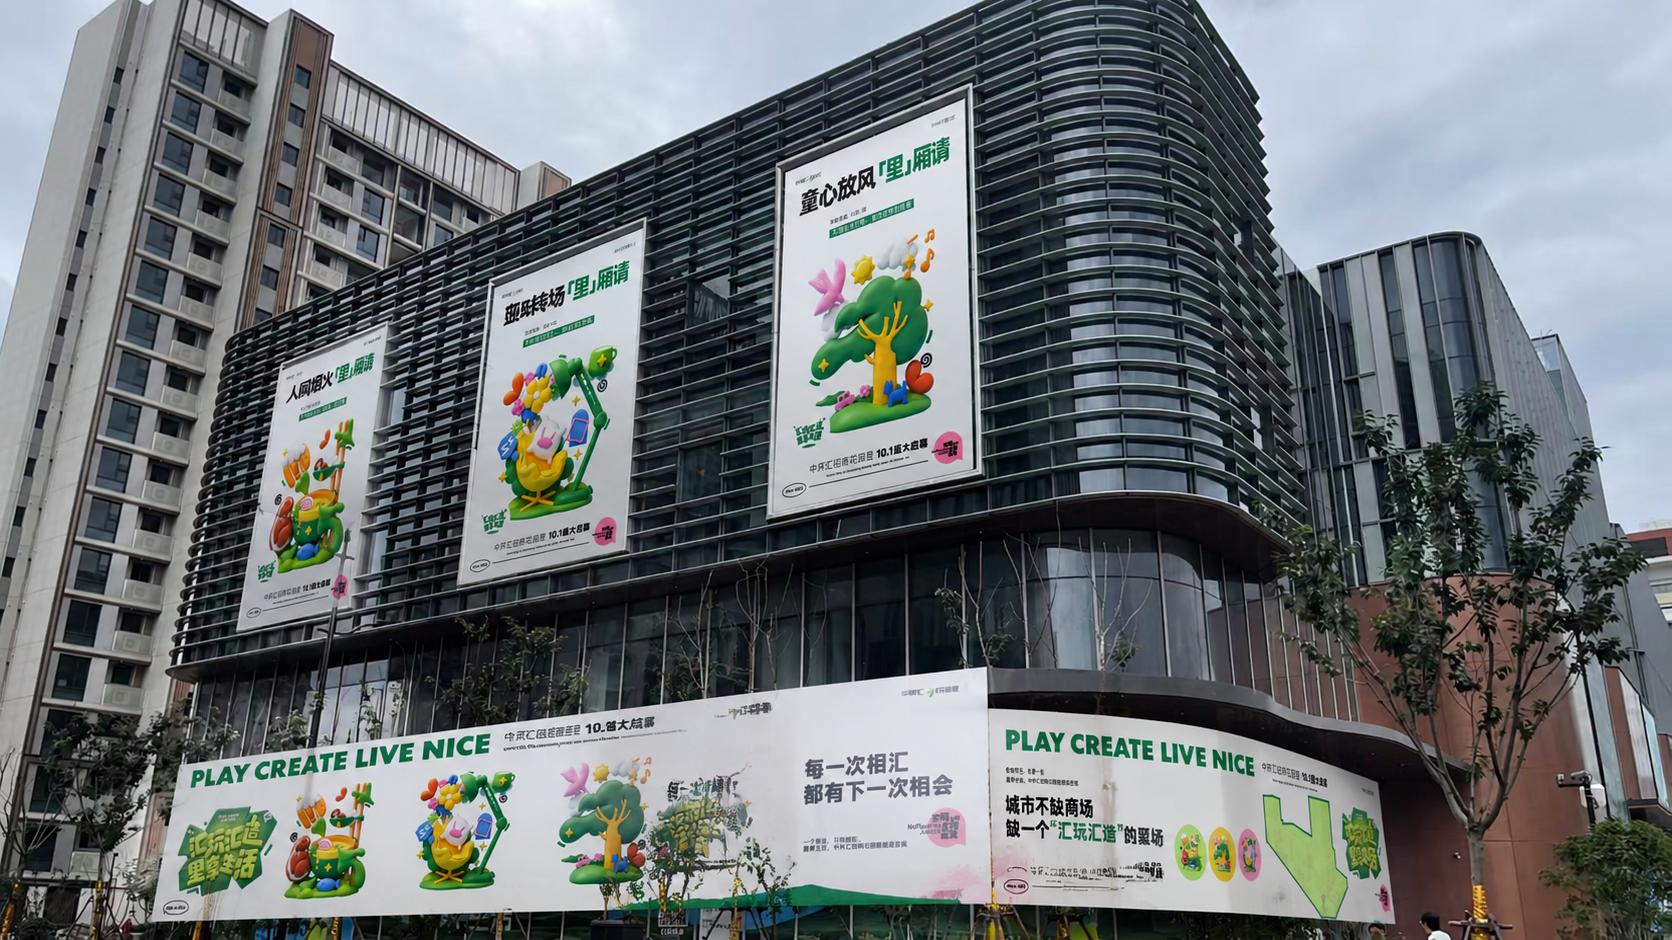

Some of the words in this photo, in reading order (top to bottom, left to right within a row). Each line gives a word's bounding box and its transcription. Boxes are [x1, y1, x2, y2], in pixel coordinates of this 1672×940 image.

[191, 763, 251, 788] PLAY
[254, 751, 348, 780] CREATE
[355, 742, 415, 769] LIVE
[422, 733, 491, 760] NICE
[804, 751, 909, 780] 每一次相汇
[1005, 729, 1065, 753] PLAY
[1070, 733, 1154, 761] CREATE
[1161, 741, 1207, 768] LIVE
[1212, 748, 1255, 777] NICE
[803, 774, 953, 805] 都有下一次相会
[1005, 795, 1094, 818] 城市不缺商场
